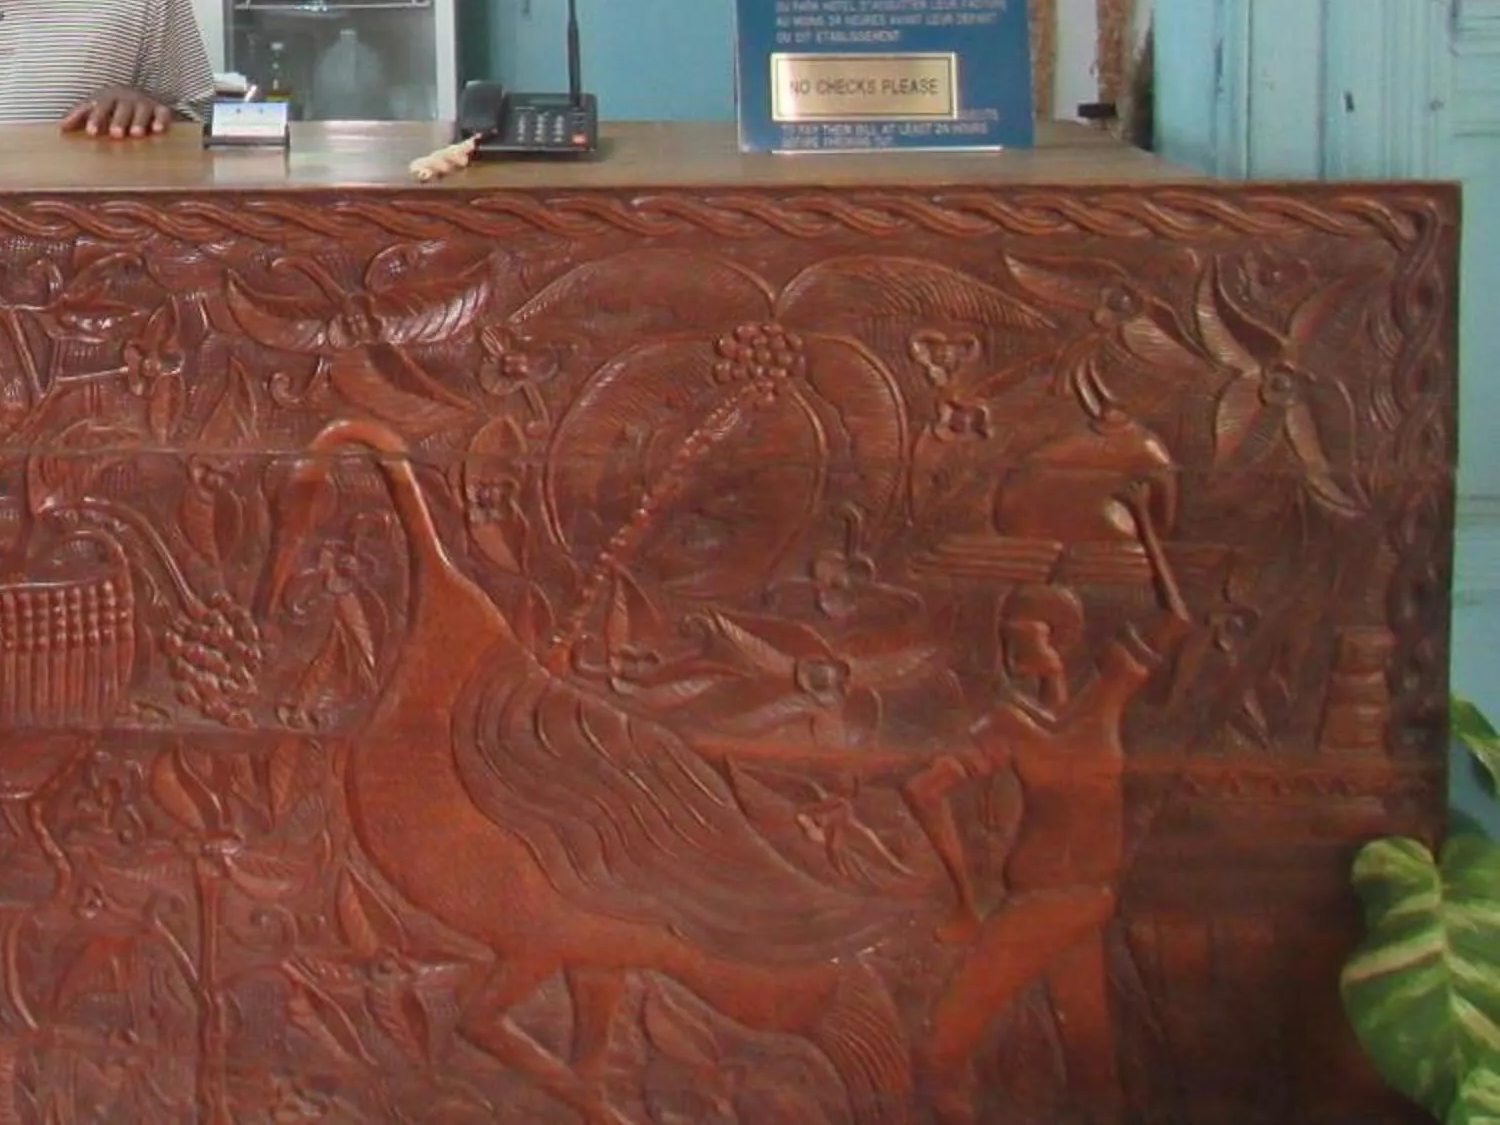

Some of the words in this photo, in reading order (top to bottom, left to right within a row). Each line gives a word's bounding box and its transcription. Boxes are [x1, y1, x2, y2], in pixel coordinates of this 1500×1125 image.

[789, 78, 811, 95] NO
[816, 78, 876, 95] CHECKS
[882, 77, 940, 95] PLEASE
